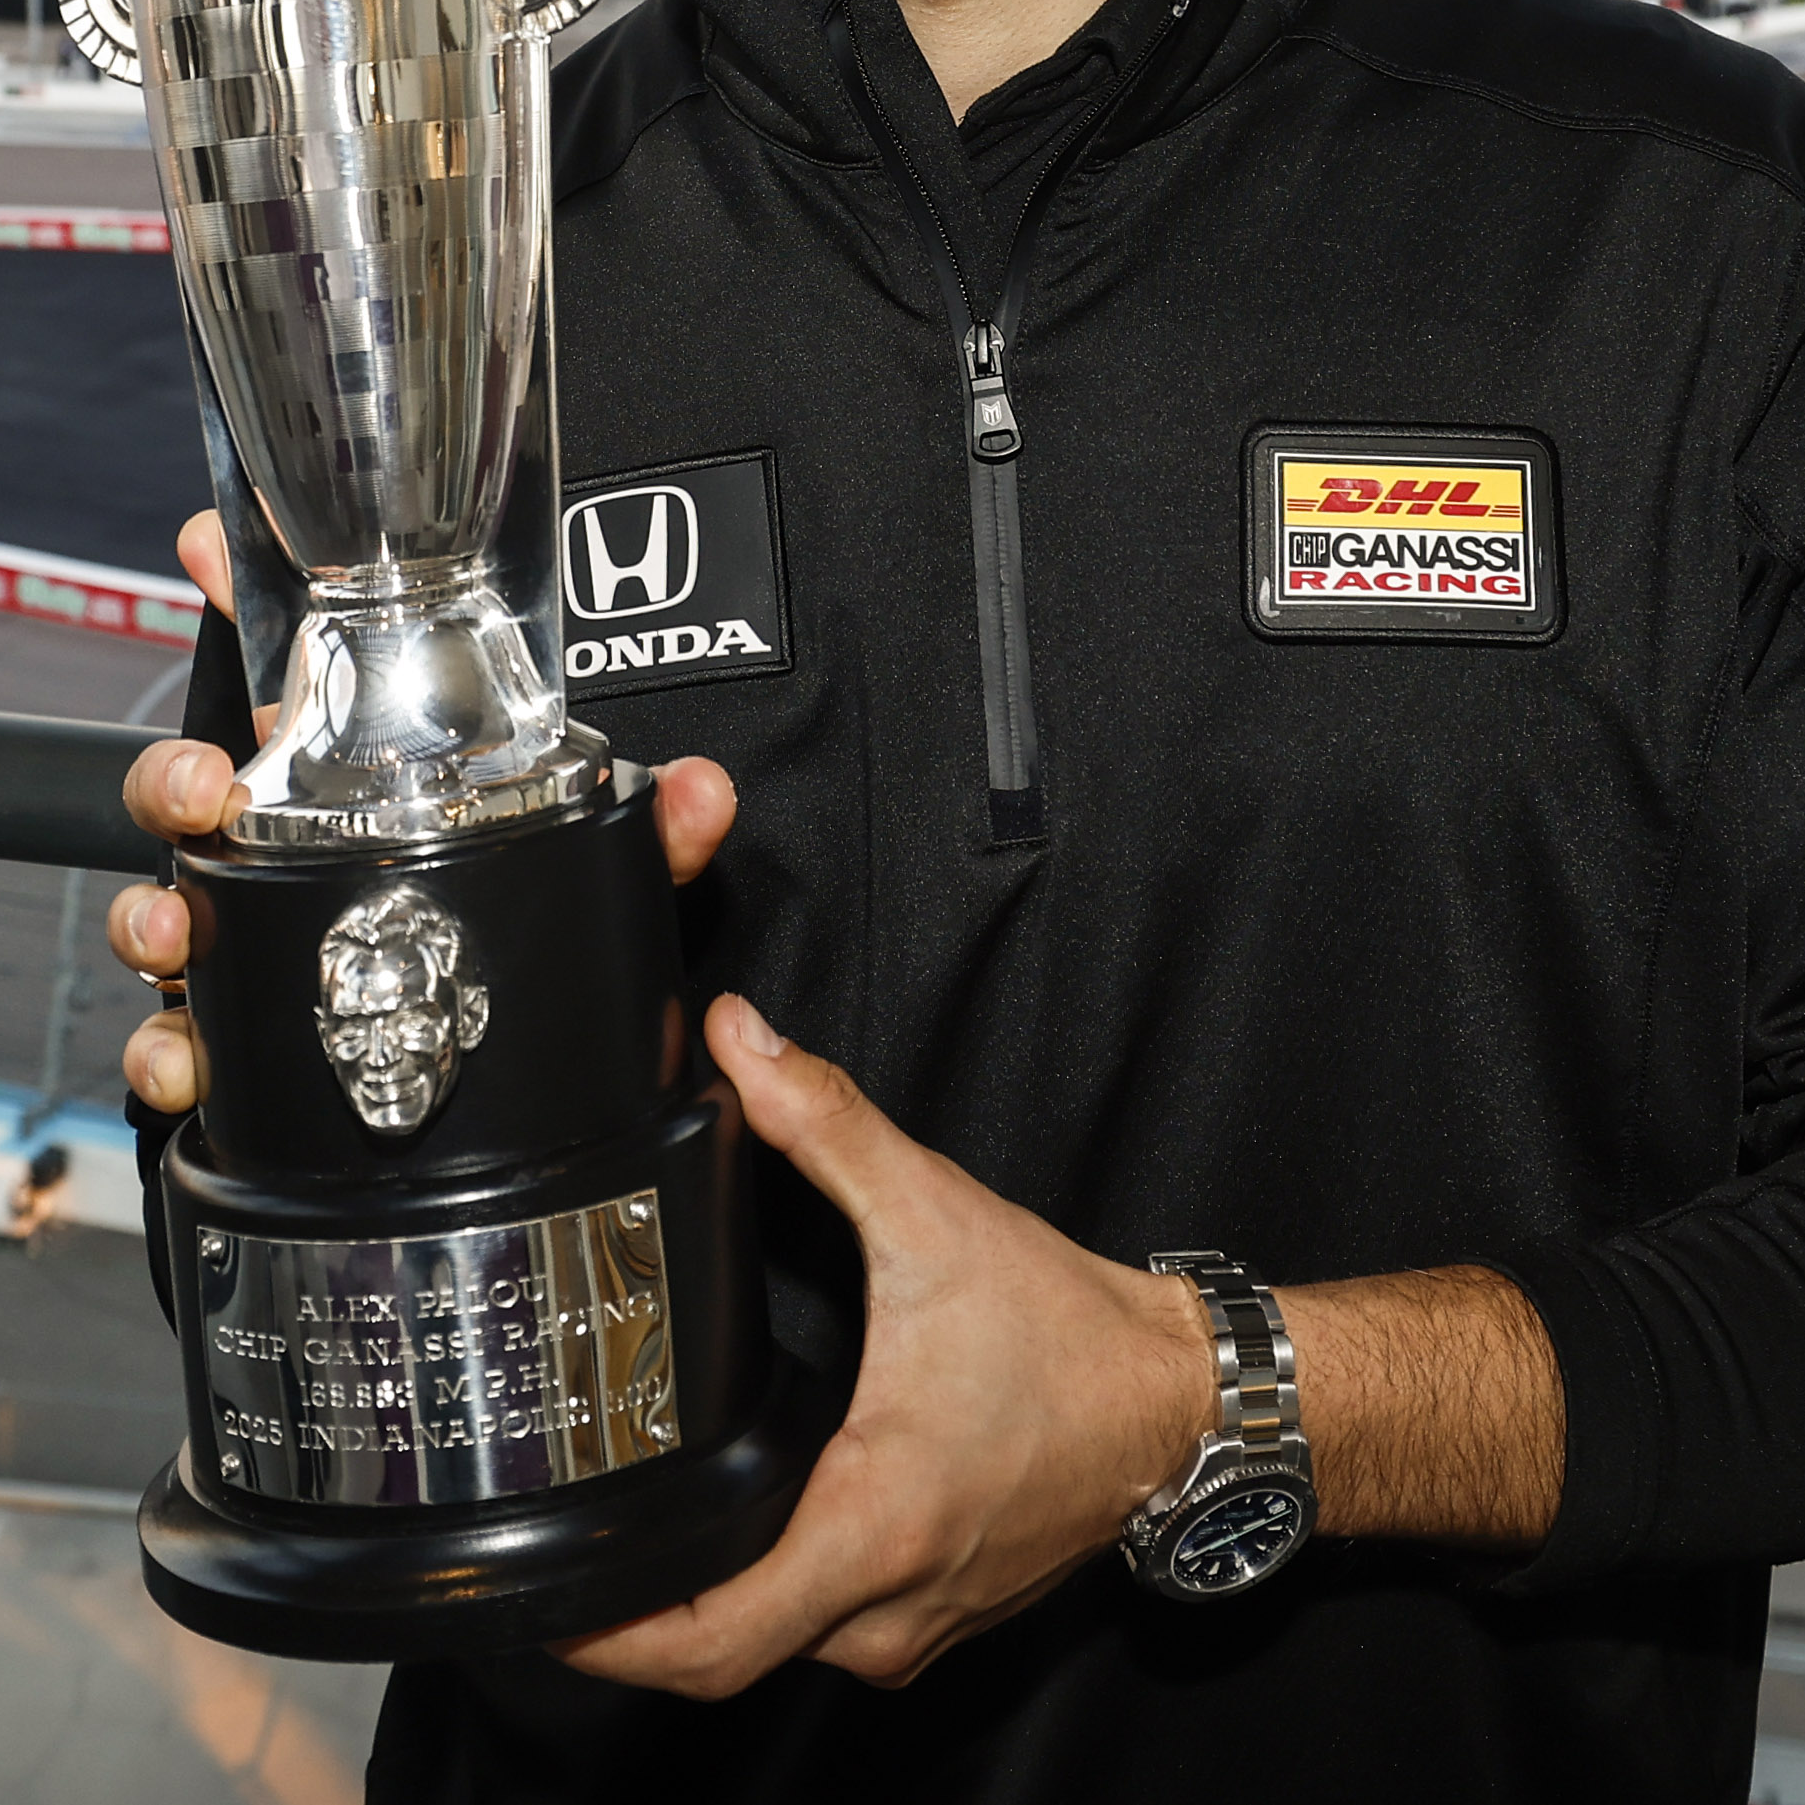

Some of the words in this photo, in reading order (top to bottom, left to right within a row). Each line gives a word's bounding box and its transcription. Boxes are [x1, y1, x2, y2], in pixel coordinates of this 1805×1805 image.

[1317, 478, 1491, 517] DHL
[1292, 534, 1328, 566] CHIP
[1332, 533, 1521, 572] GANASSI
[1289, 571, 1521, 595] RACING
[564, 619, 772, 679] ONDA
[296, 1294, 397, 1323] ALEX
[414, 1273, 547, 1319] PALOU
[214, 1325, 288, 1362] CHIP
[303, 1328, 485, 1366] GANASSI
[223, 1409, 284, 1446] 2025
[296, 1395, 592, 1453] INDIANAPOLIS
